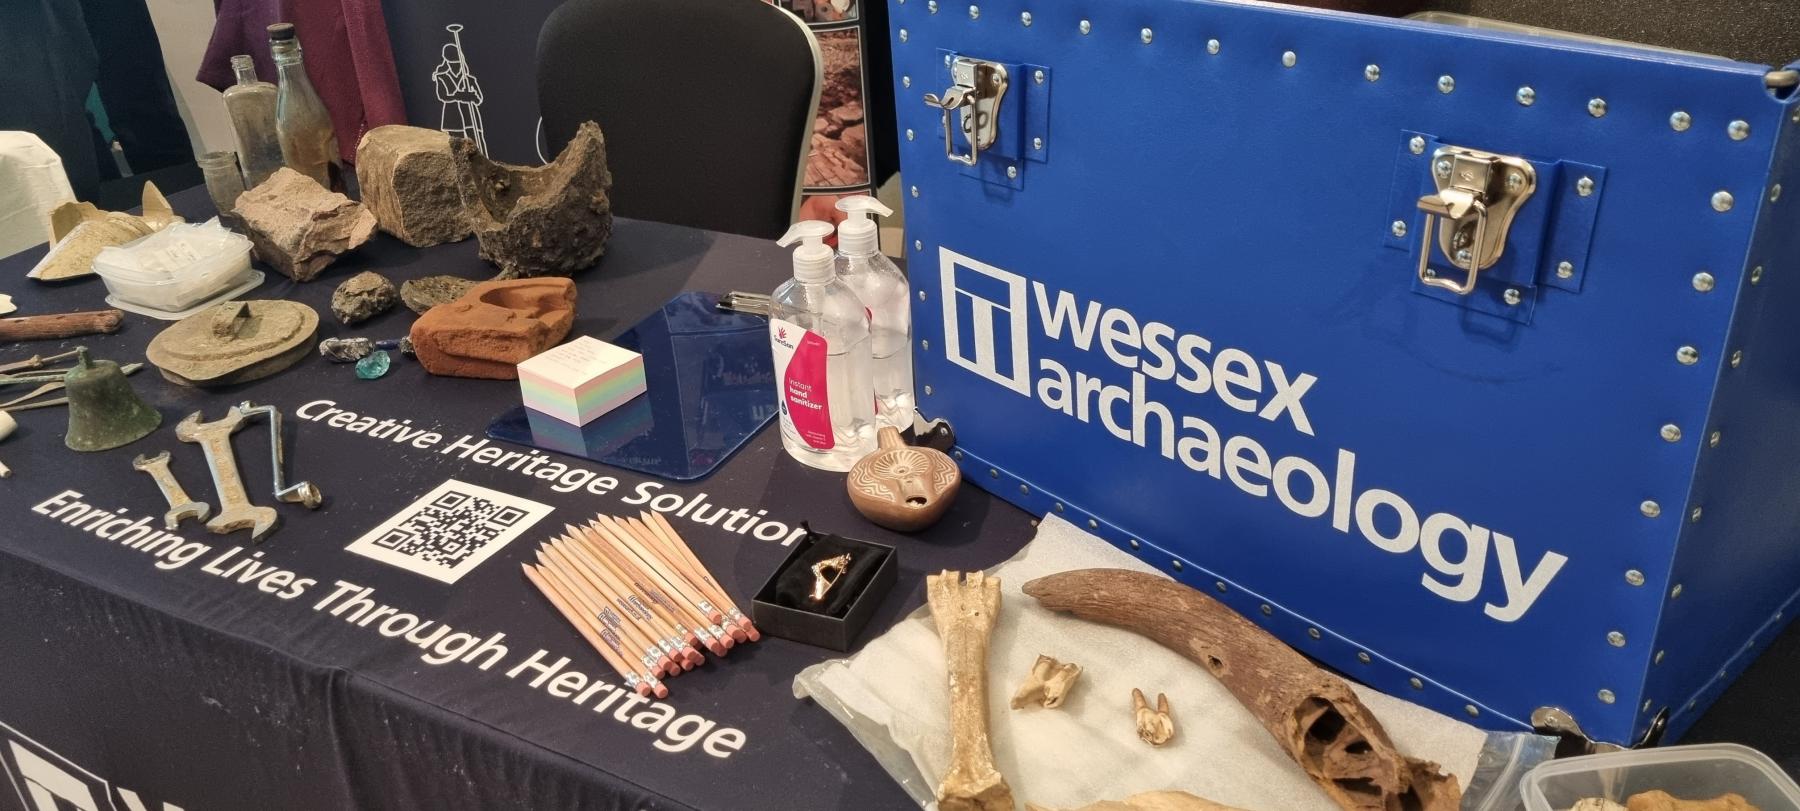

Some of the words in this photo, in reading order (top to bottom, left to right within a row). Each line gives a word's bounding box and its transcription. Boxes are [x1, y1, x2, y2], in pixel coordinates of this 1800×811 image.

[789, 385, 808, 398] hand
[790, 396, 823, 410] sanitizer
[1033, 281, 1317, 436] wessex
[296, 399, 442, 449] Creative
[440, 434, 619, 495] Heritage
[1037, 359, 1568, 622] archaeology
[31, 489, 211, 570] Enriching
[201, 546, 317, 600] Lives
[312, 579, 508, 671] Through
[506, 648, 747, 758] Heritage
